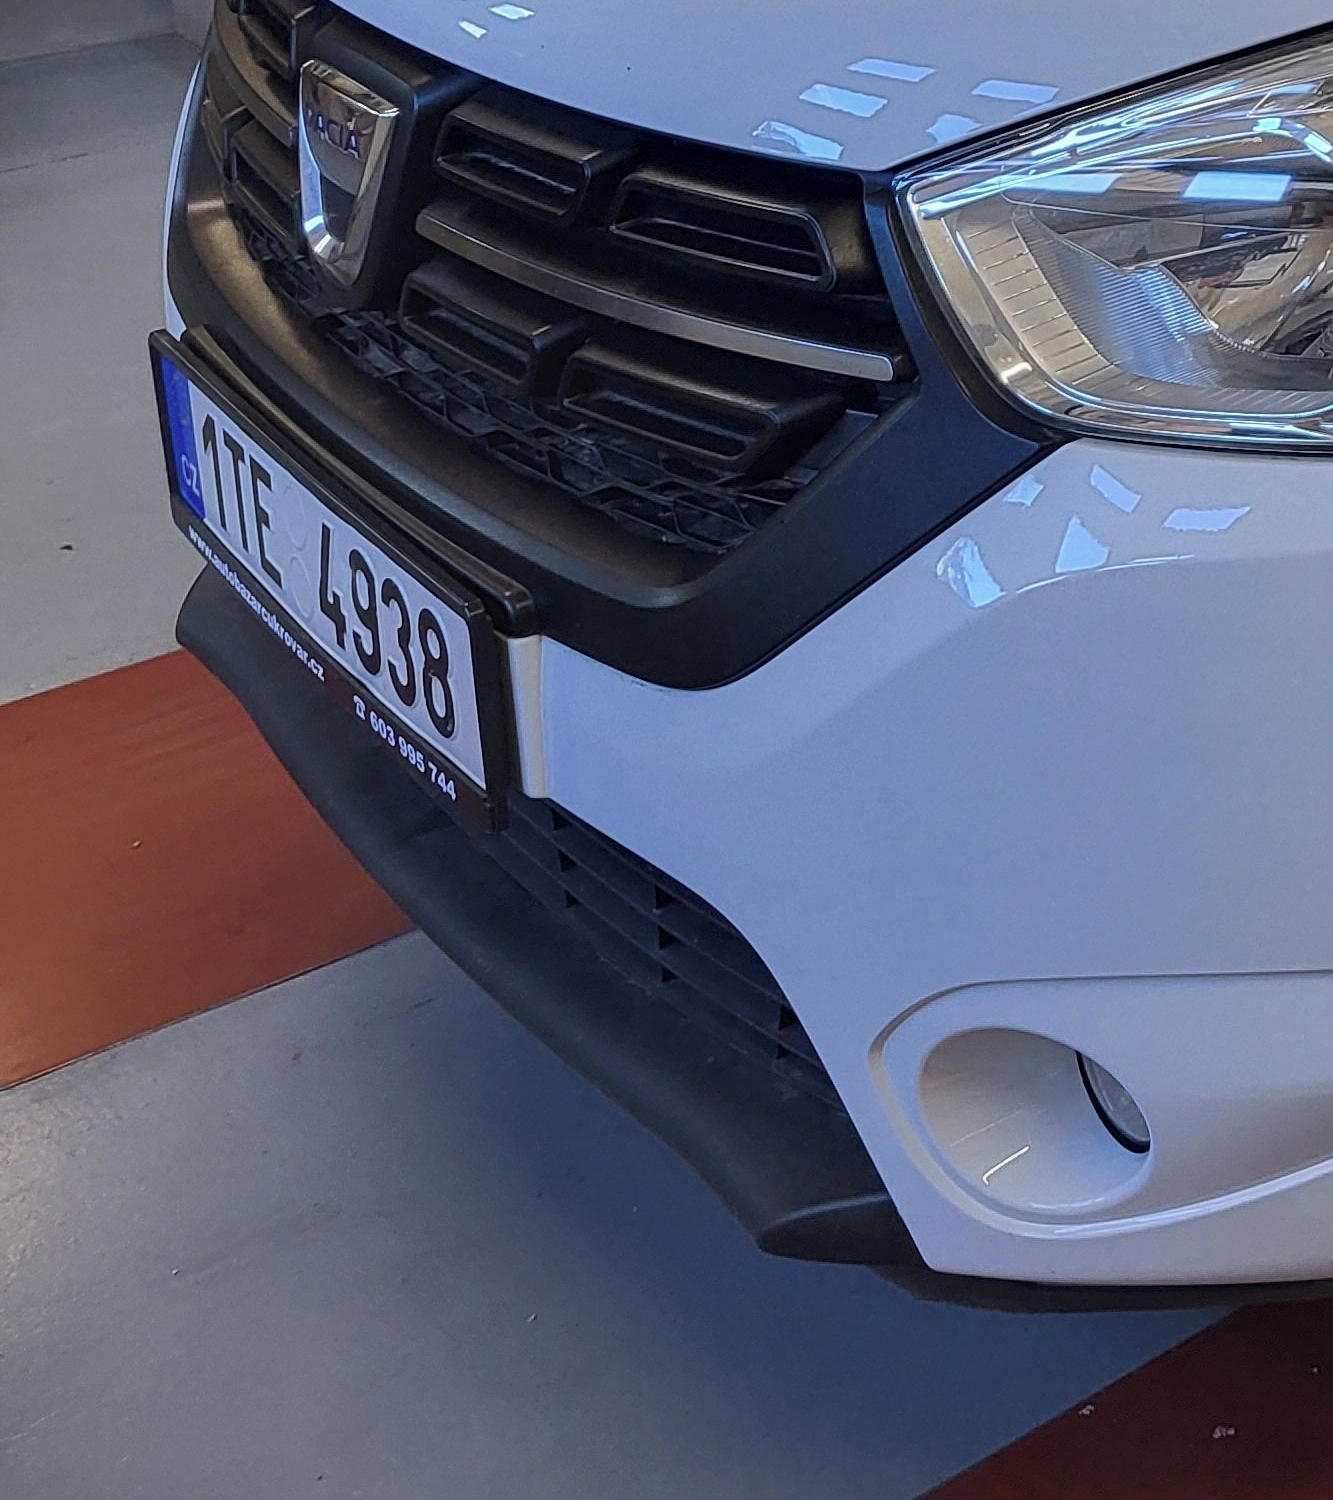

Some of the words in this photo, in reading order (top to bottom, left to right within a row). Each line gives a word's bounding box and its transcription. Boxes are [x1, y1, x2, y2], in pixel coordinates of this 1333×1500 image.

[181, 453, 201, 496] CZ
[187, 523, 327, 683] www.autobazarcukrovar.cz
[202, 413, 283, 589] 1TE
[319, 521, 455, 739] 4938
[369, 710, 397, 748] 603
[398, 734, 425, 774] 995
[427, 759, 457, 802] 744
